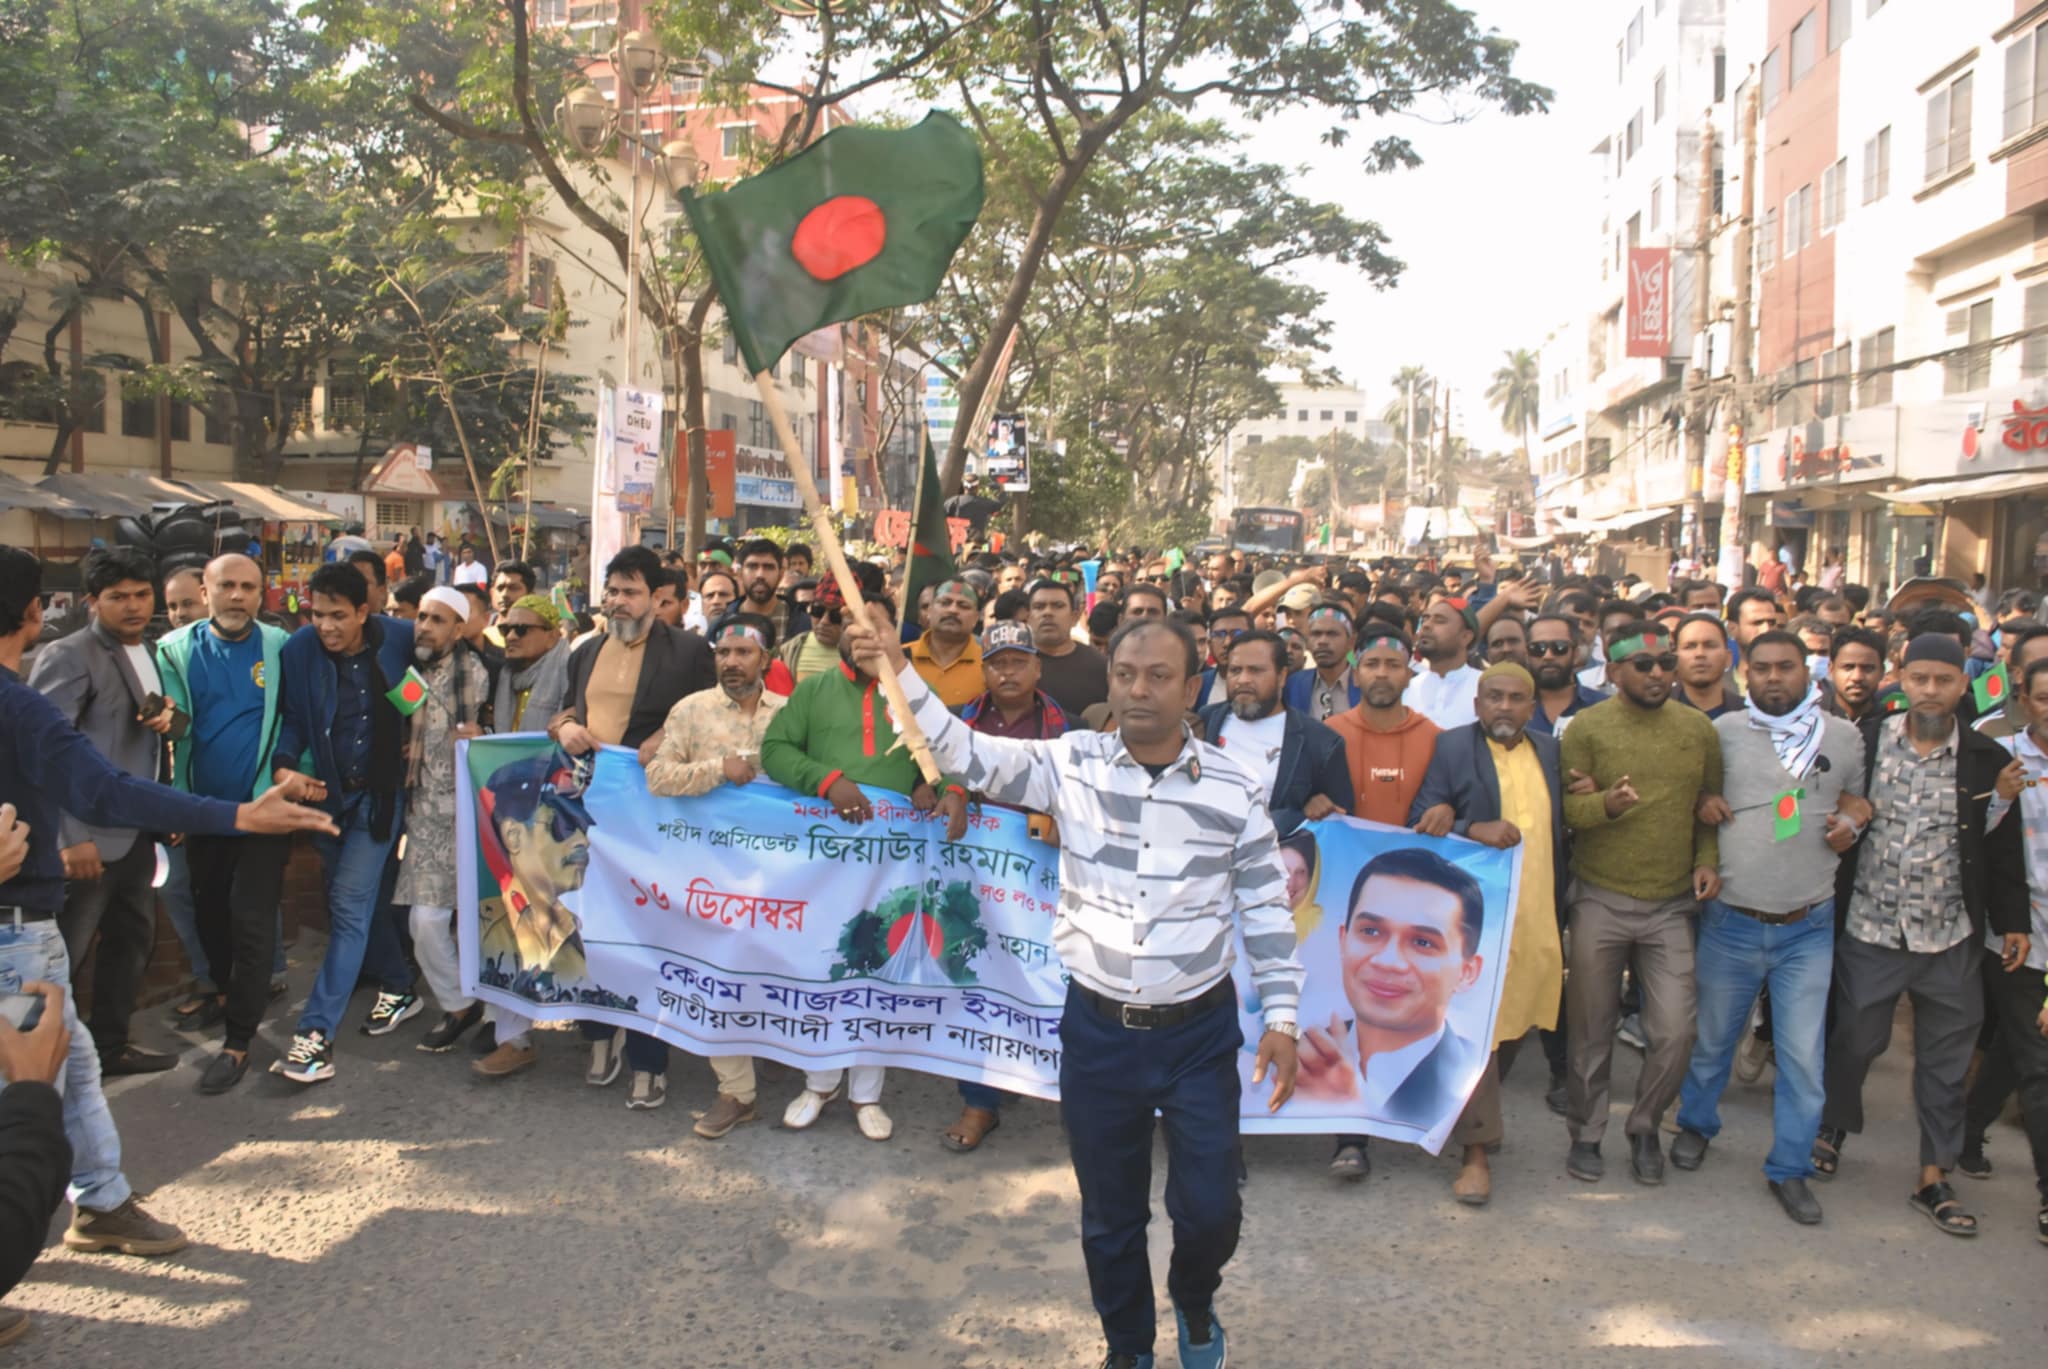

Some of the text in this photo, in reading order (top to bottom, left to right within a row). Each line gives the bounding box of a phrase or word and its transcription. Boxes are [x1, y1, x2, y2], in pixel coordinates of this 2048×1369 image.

[656, 818, 1060, 892] শহীদ প্রেসিডেন্ট জিয়াউর রহমান বী
[630, 877, 809, 932] ১৬ ডিসেম্বর
[997, 932, 1051, 966] মহান
[660, 961, 747, 1003] কেএম
[760, 984, 947, 1015] মাজহারুল
[656, 986, 1061, 1071] জাতীয়তাবাদী যুবদল নারায়ণগ
